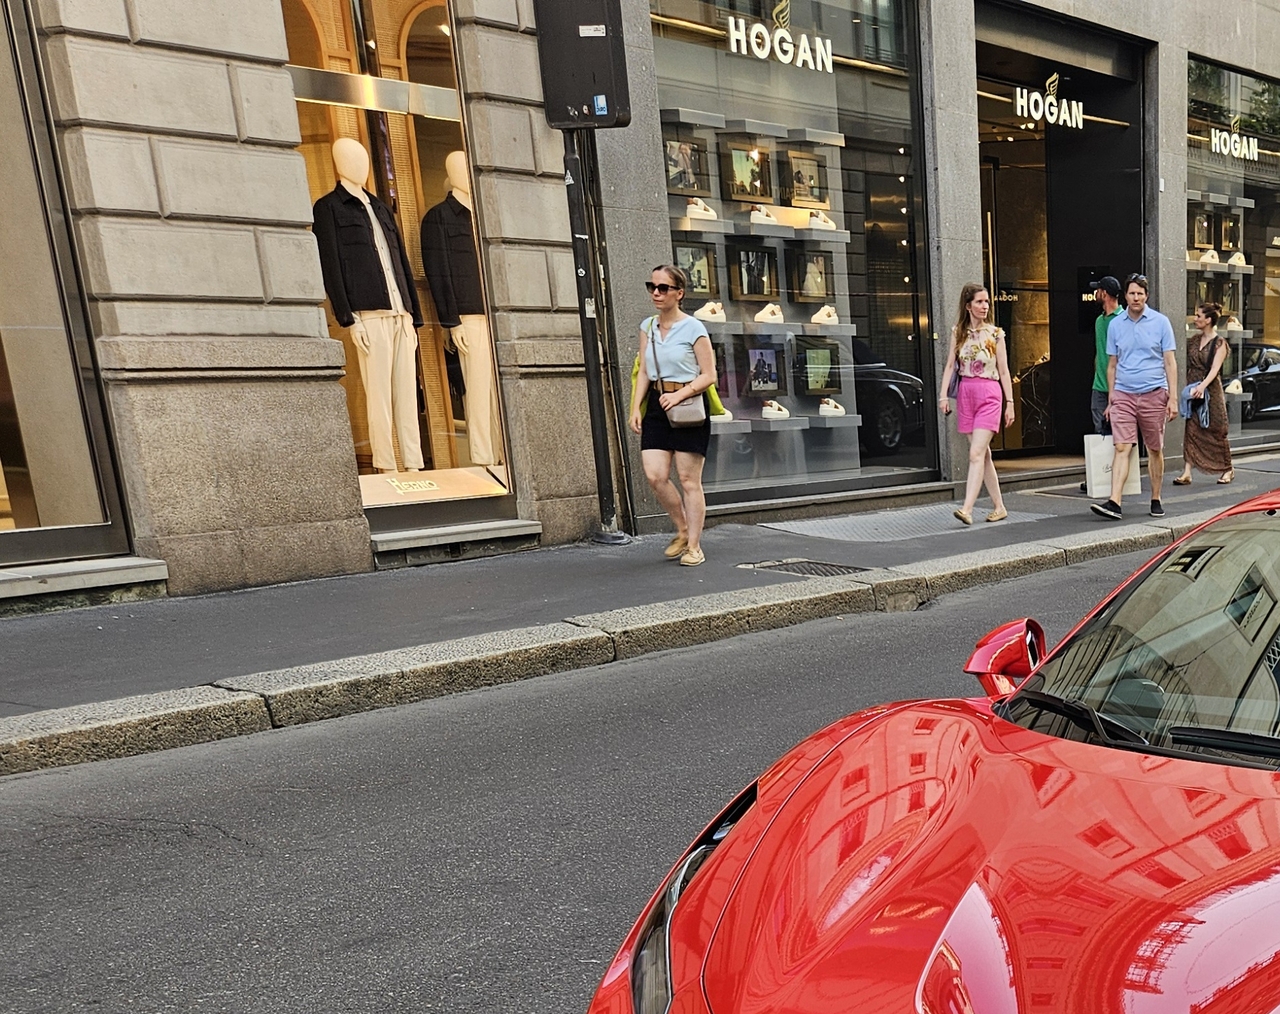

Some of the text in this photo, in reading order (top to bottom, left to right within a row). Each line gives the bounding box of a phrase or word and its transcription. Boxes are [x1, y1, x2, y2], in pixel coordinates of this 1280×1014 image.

[728, 16, 833, 73] HOGAN
[1016, 87, 1083, 129] HOGAN
[1211, 128, 1258, 161] HOGAN
